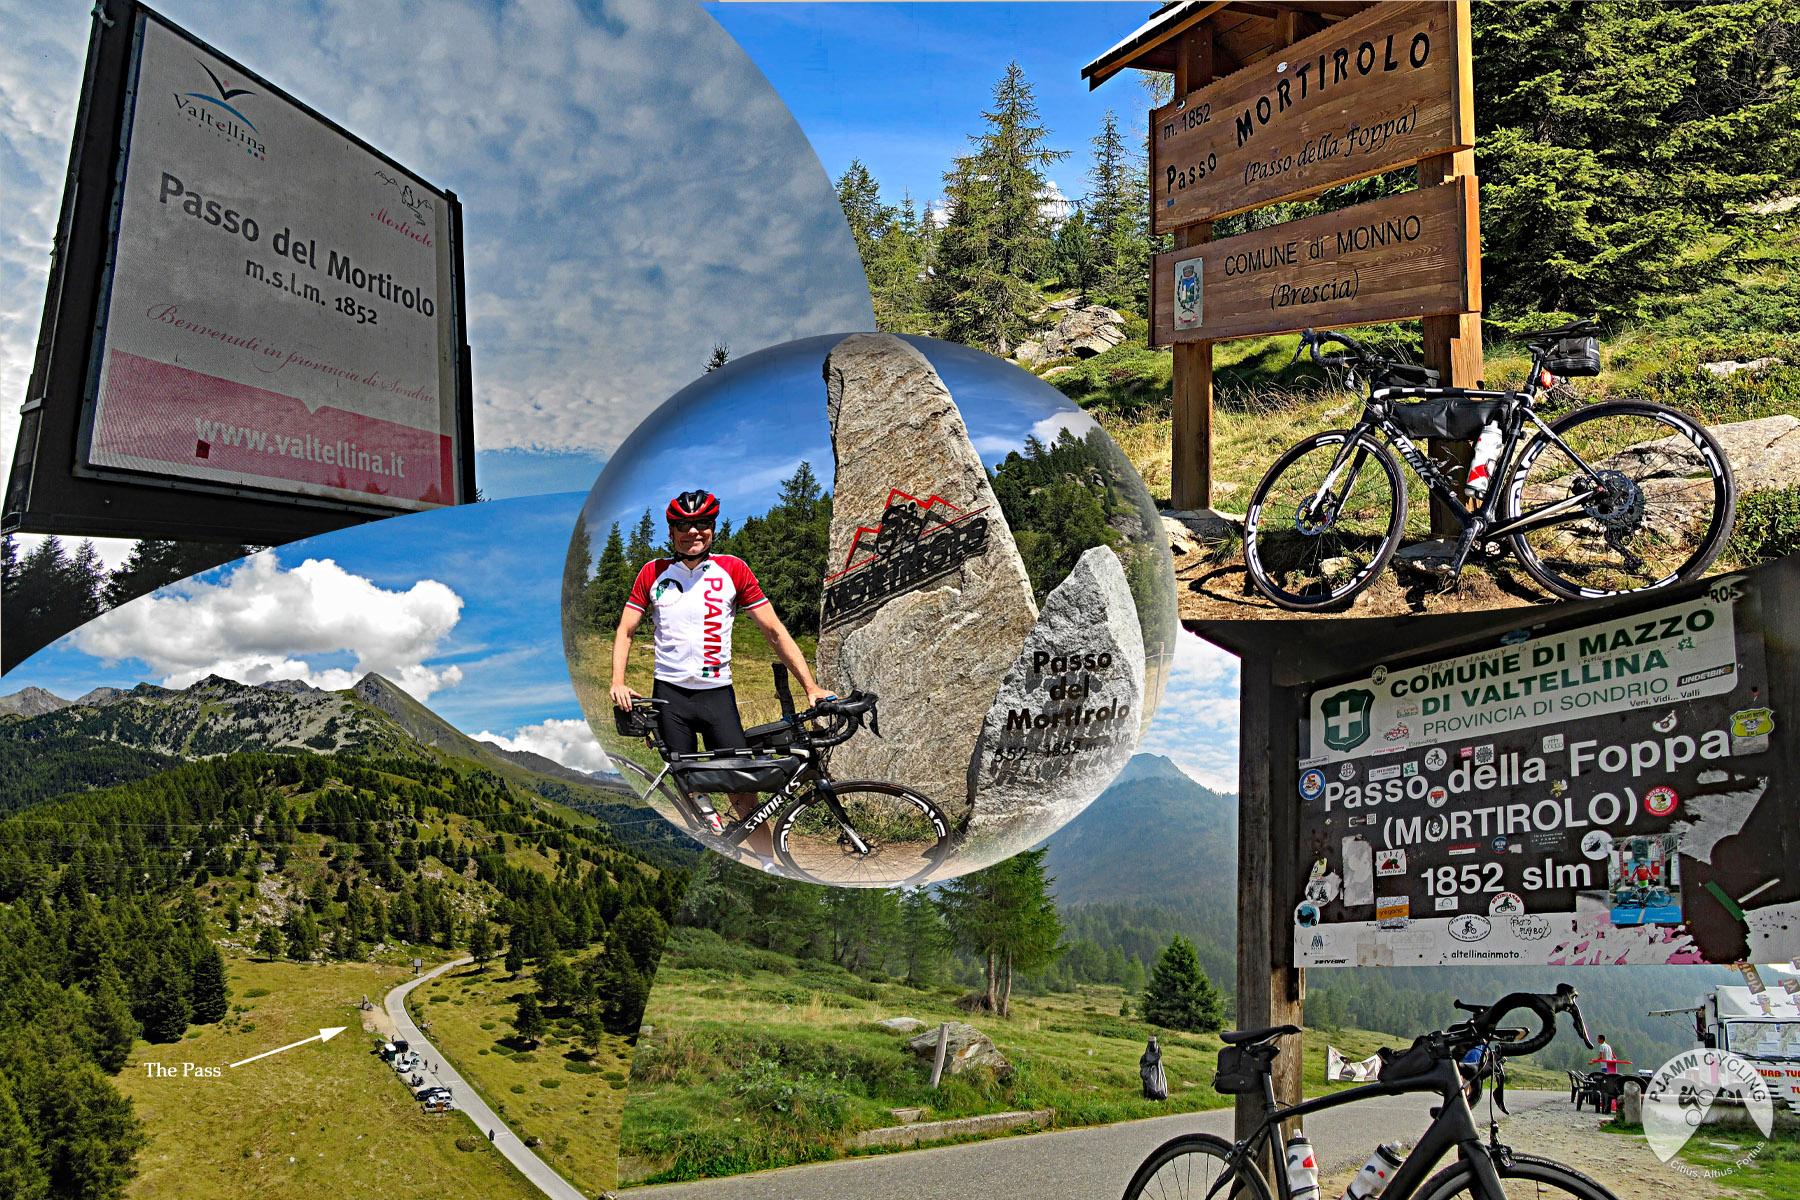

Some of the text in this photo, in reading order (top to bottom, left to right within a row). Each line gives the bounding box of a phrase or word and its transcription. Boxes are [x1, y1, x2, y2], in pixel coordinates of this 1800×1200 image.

[172, 92, 267, 154] Valtellina
[1166, 31, 1431, 194] Passo MORTIROLO
[1181, 102, 1211, 132] 1852
[159, 171, 435, 318] Passo del Mortirolo
[370, 207, 433, 247] Mortirolo
[1224, 214, 1421, 277] COMUNE di MONNO
[245, 259, 378, 325] m.s.l.m. 1852
[1271, 269, 1360, 311] (Brescia)
[146, 303, 436, 403] Benvenuti in provincia di Sondrio
[195, 417, 405, 478] www.valtellina.it
[825, 516, 989, 613] MORTIROLO
[703, 577, 723, 666] PJAMM
[1033, 651, 1112, 674] Passo
[1390, 653, 1521, 698] COMUNE
[1532, 642, 1565, 668] DI
[1578, 608, 1715, 657] MAZZO
[1422, 693, 1450, 717] DI
[1461, 648, 1669, 708] VALTELLINA
[1006, 697, 1130, 731] Mortirolo
[1049, 674, 1090, 701] del
[1423, 705, 1527, 737] PROVINCIA
[1533, 699, 1553, 716] DI
[1560, 677, 1668, 711] SONDRIO
[1680, 688, 1700, 699] Valli
[993, 745, 1029, 762] 552
[1045, 740, 1080, 758] 1852
[1325, 728, 1732, 812] Passo della Foppa
[1420, 861, 1505, 897] 1852
[1522, 857, 1592, 891] slm
